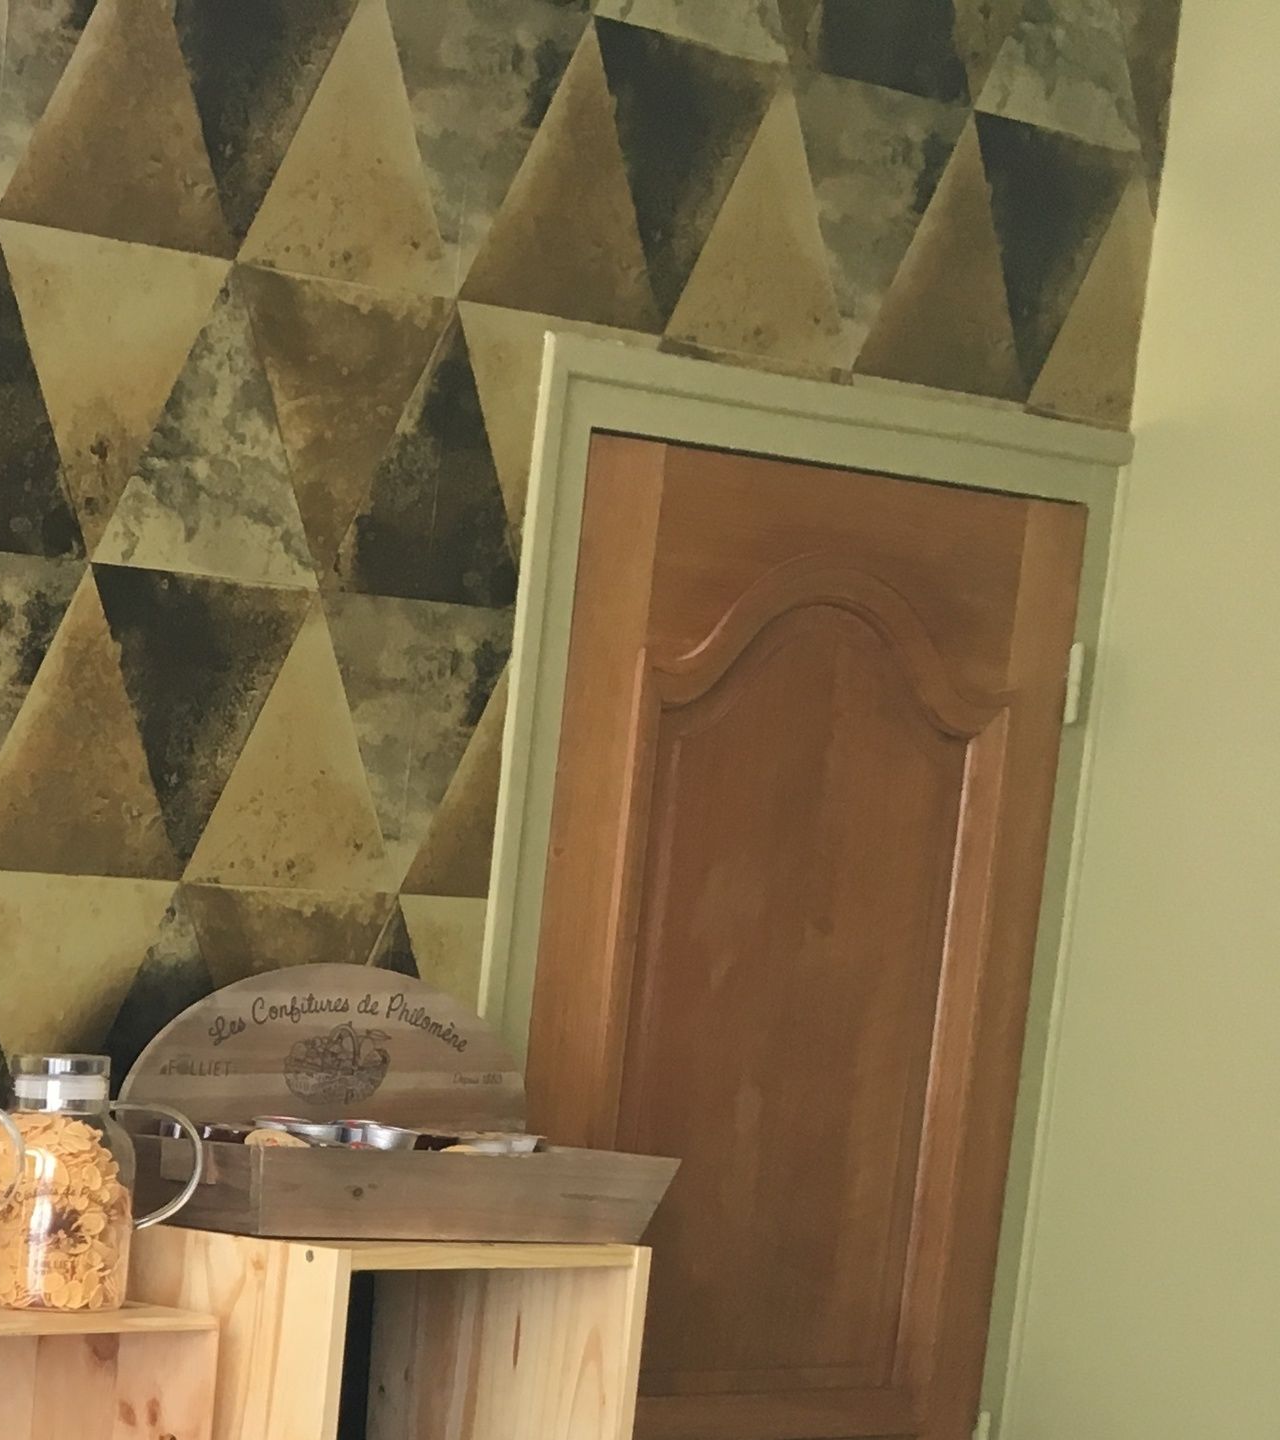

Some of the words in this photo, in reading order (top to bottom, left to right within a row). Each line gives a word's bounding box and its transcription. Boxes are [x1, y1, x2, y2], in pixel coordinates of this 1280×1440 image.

[208, 1015, 246, 1046] Les
[252, 993, 350, 1025] Confitures
[357, 994, 380, 1015] de
[385, 993, 468, 1053] Philomène
